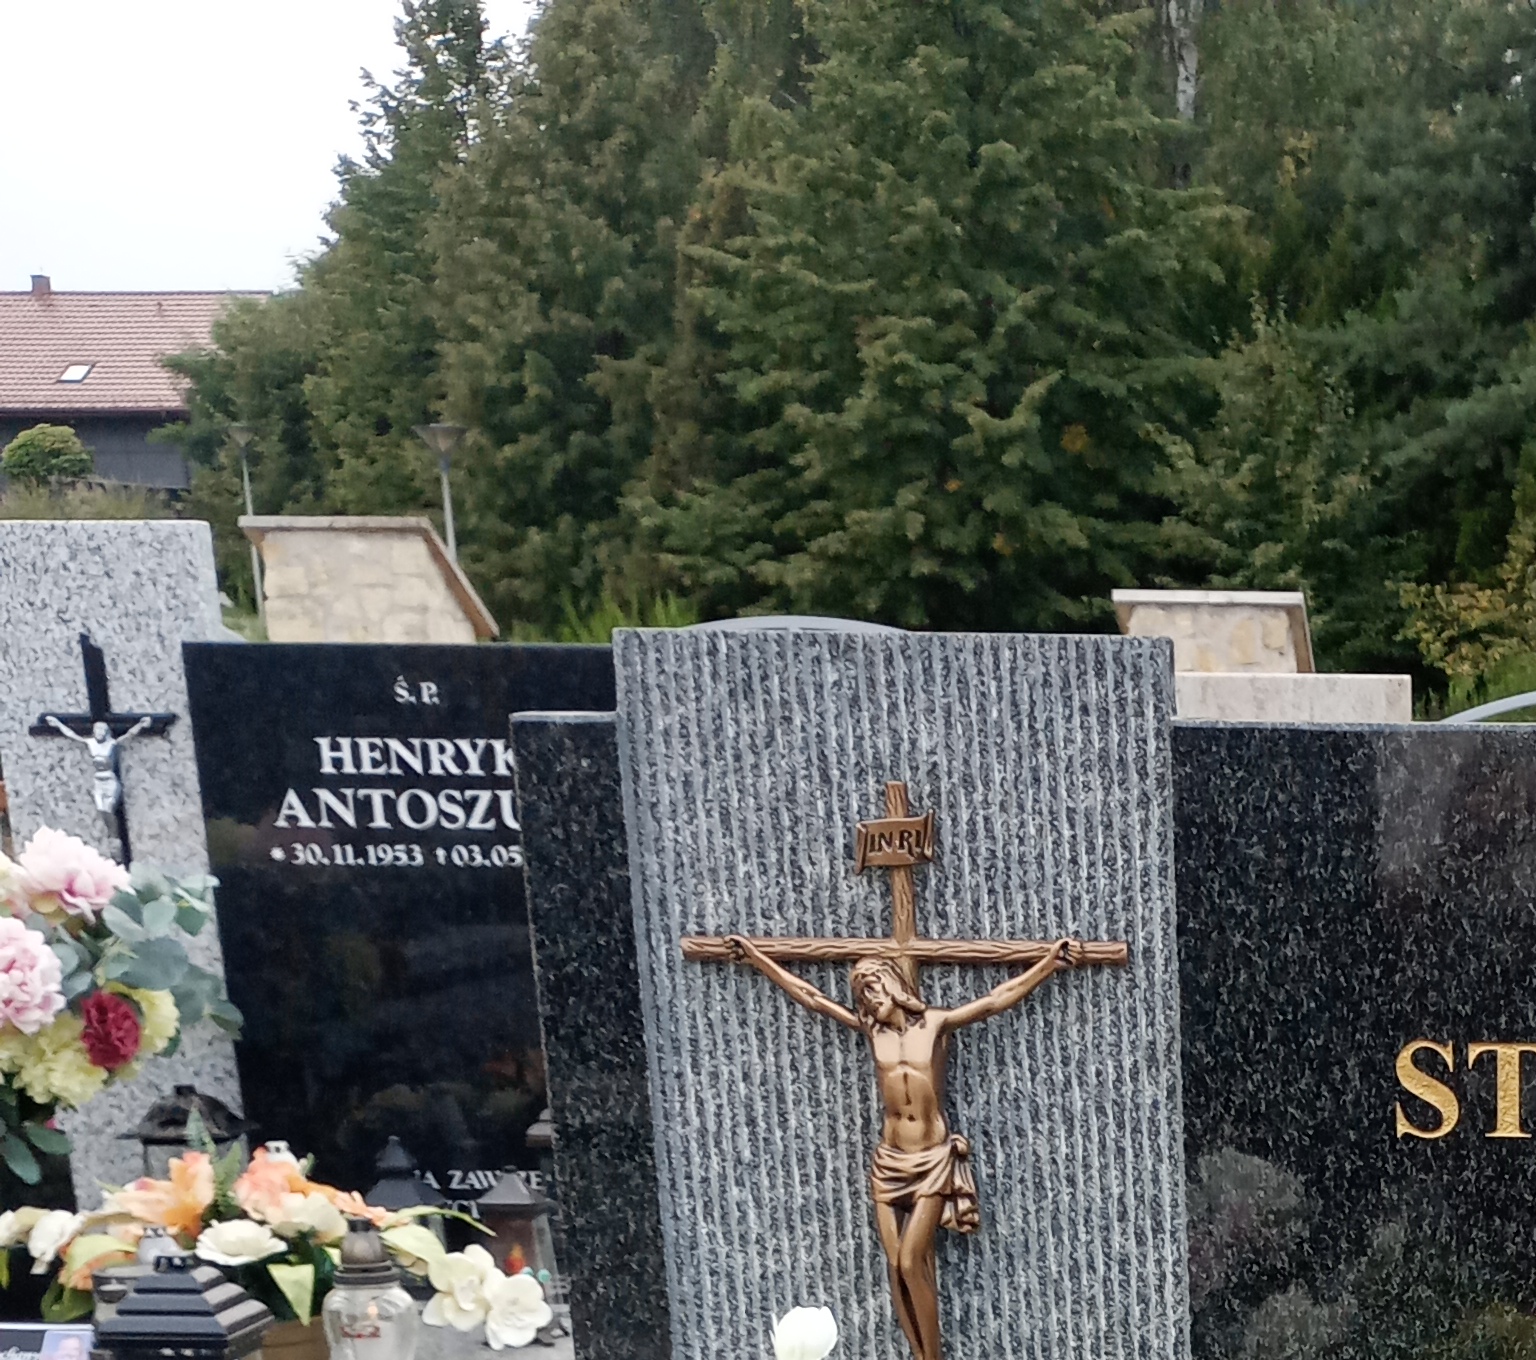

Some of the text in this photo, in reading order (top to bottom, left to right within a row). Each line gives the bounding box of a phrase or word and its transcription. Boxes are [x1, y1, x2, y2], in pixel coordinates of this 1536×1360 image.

[273, 788, 522, 831] ANTOSZU
[290, 843, 525, 868] 30.11.1953 03.05
